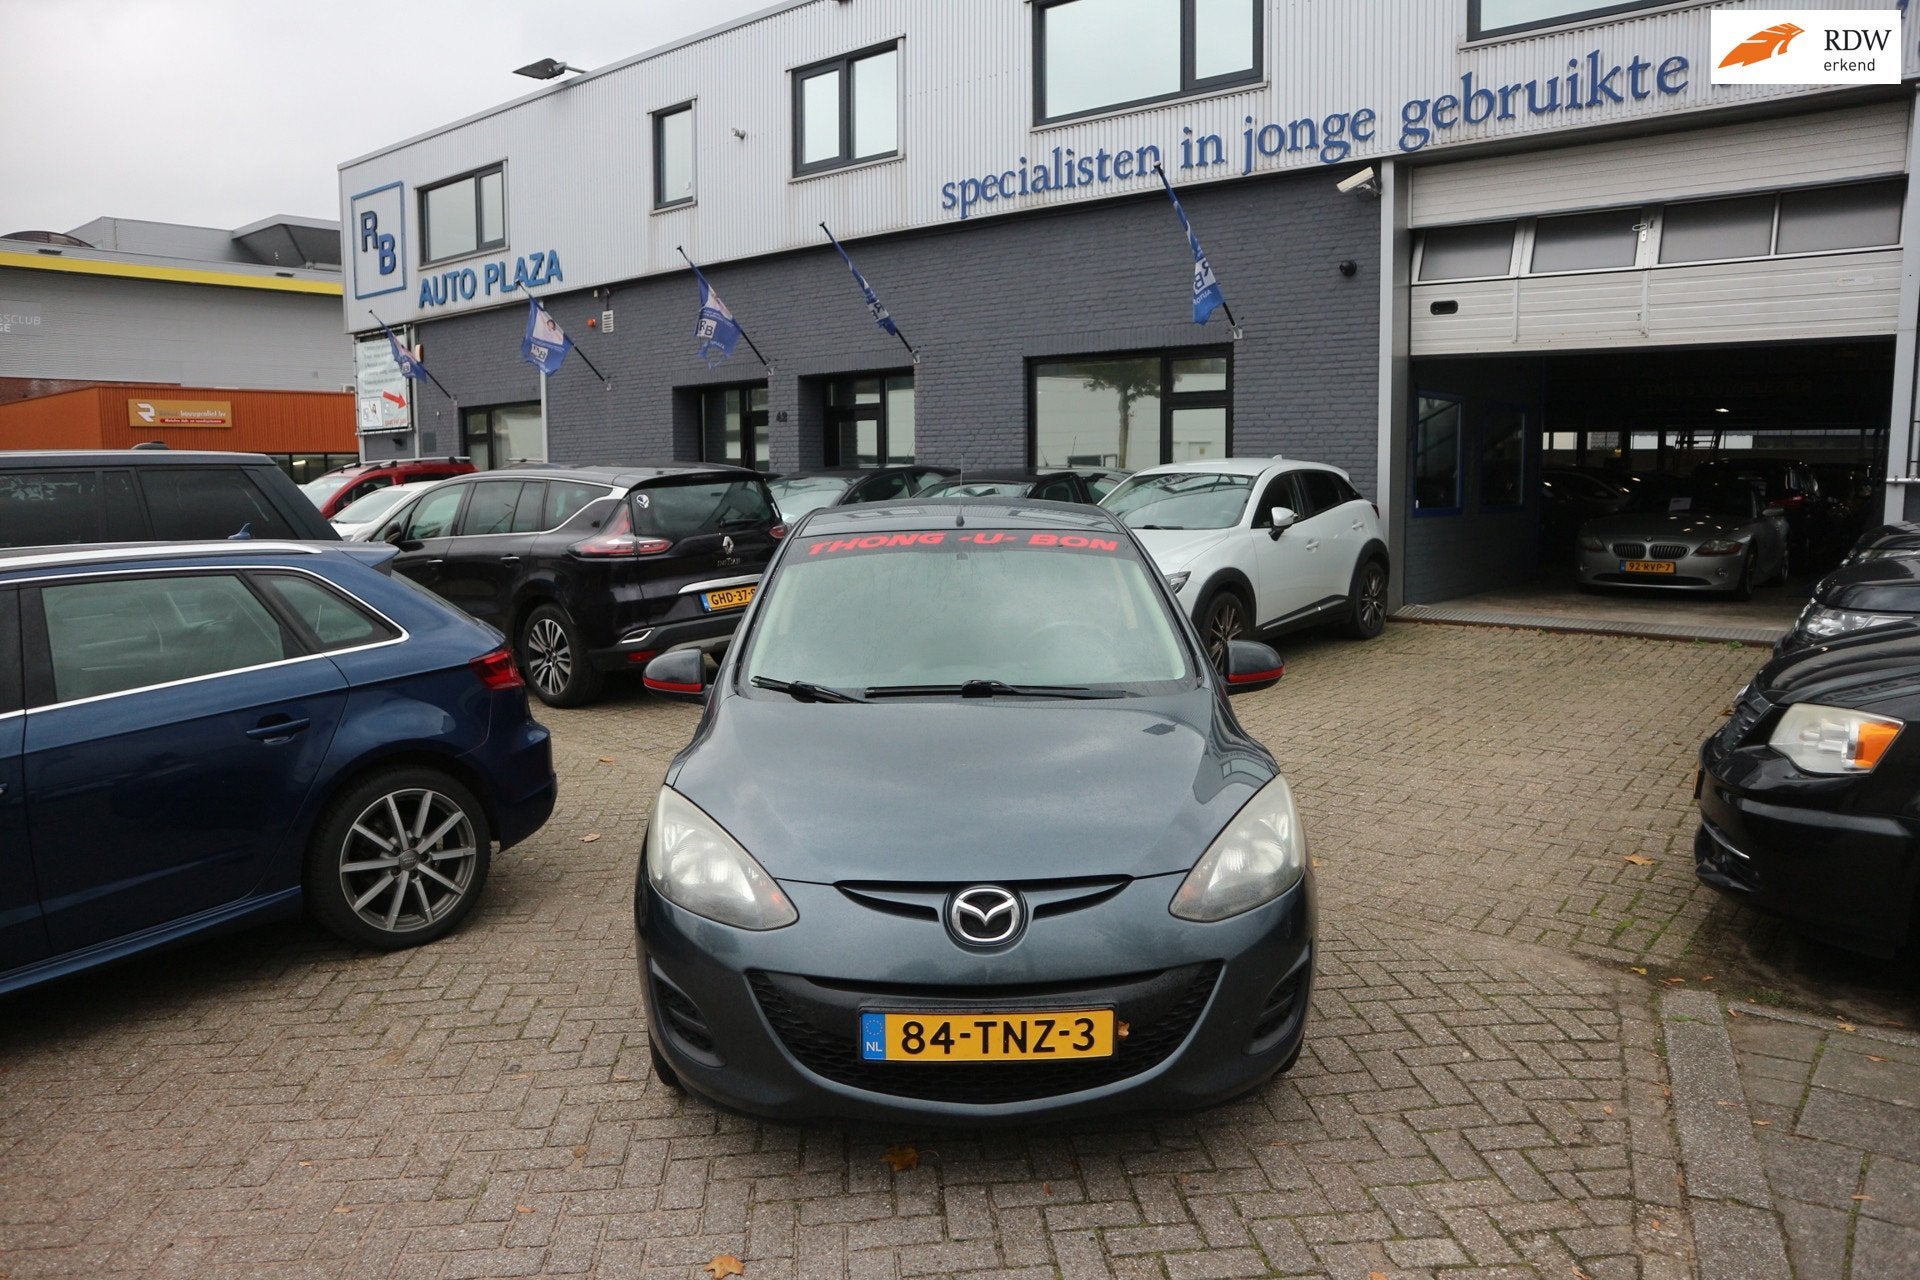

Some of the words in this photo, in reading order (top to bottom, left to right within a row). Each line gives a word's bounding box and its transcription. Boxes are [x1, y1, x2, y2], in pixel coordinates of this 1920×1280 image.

[942, 142, 1161, 220] specialisten
[1180, 126, 1225, 171] in
[1241, 107, 1376, 176] jonge
[1398, 49, 1691, 153] gebruikte
[418, 267, 477, 309] AUTO
[484, 249, 563, 295] PLAZA
[808, 532, 945, 556] THONG
[1027, 533, 1119, 551] BON
[866, 1041, 883, 1053] NL
[901, 1017, 1096, 1055] 84-TNZ-3
